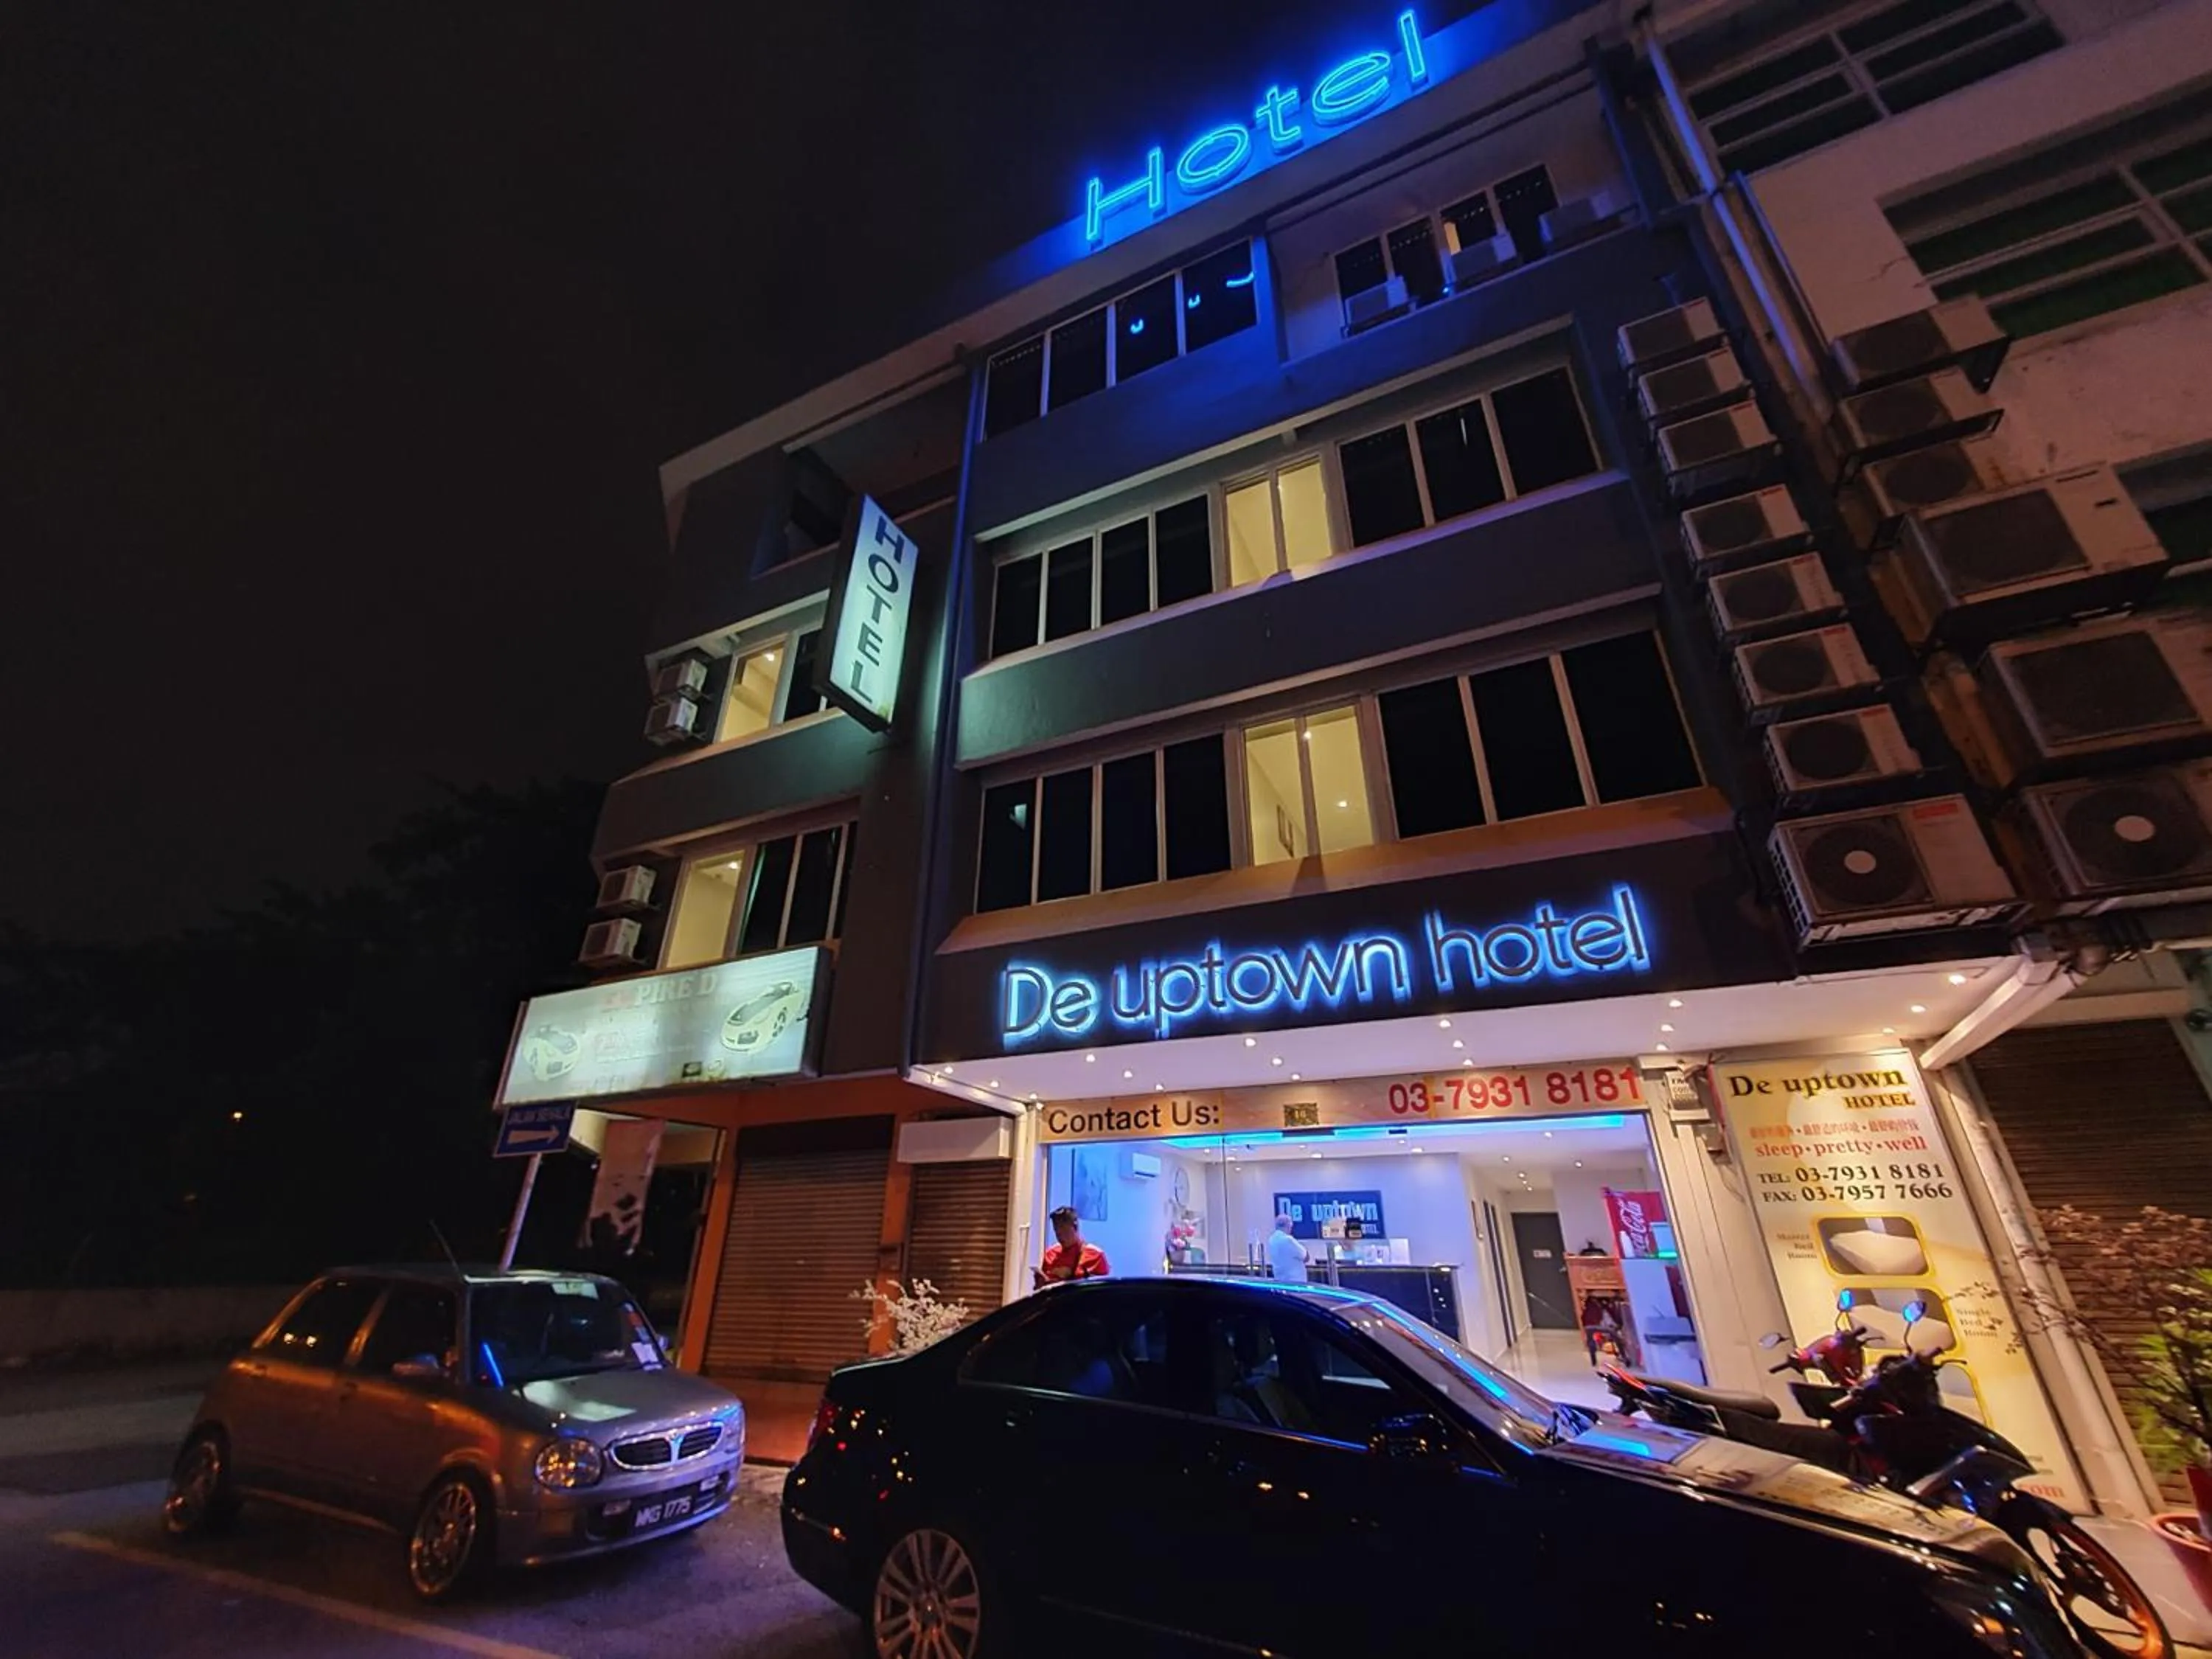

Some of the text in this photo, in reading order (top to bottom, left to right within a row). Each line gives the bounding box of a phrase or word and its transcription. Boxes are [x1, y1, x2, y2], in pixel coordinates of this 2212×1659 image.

[1085, 9, 1428, 243] Hotel
[850, 516, 905, 704] HOTEL
[1003, 887, 1649, 1040] De uptown hotel
[1048, 1105, 1161, 1134] Contact
[1172, 1100, 1220, 1126] Us:
[1388, 1075, 1531, 1115] 03-7931
[1545, 1067, 1640, 1105] 8181
[1729, 1070, 1907, 1099] De uptown
[1843, 1093, 1916, 1109] HOTEL
[1757, 1163, 1944, 1184] TEL: 03-7931 8181
[1762, 1183, 1953, 1203] FAX: 03-7957 7666
